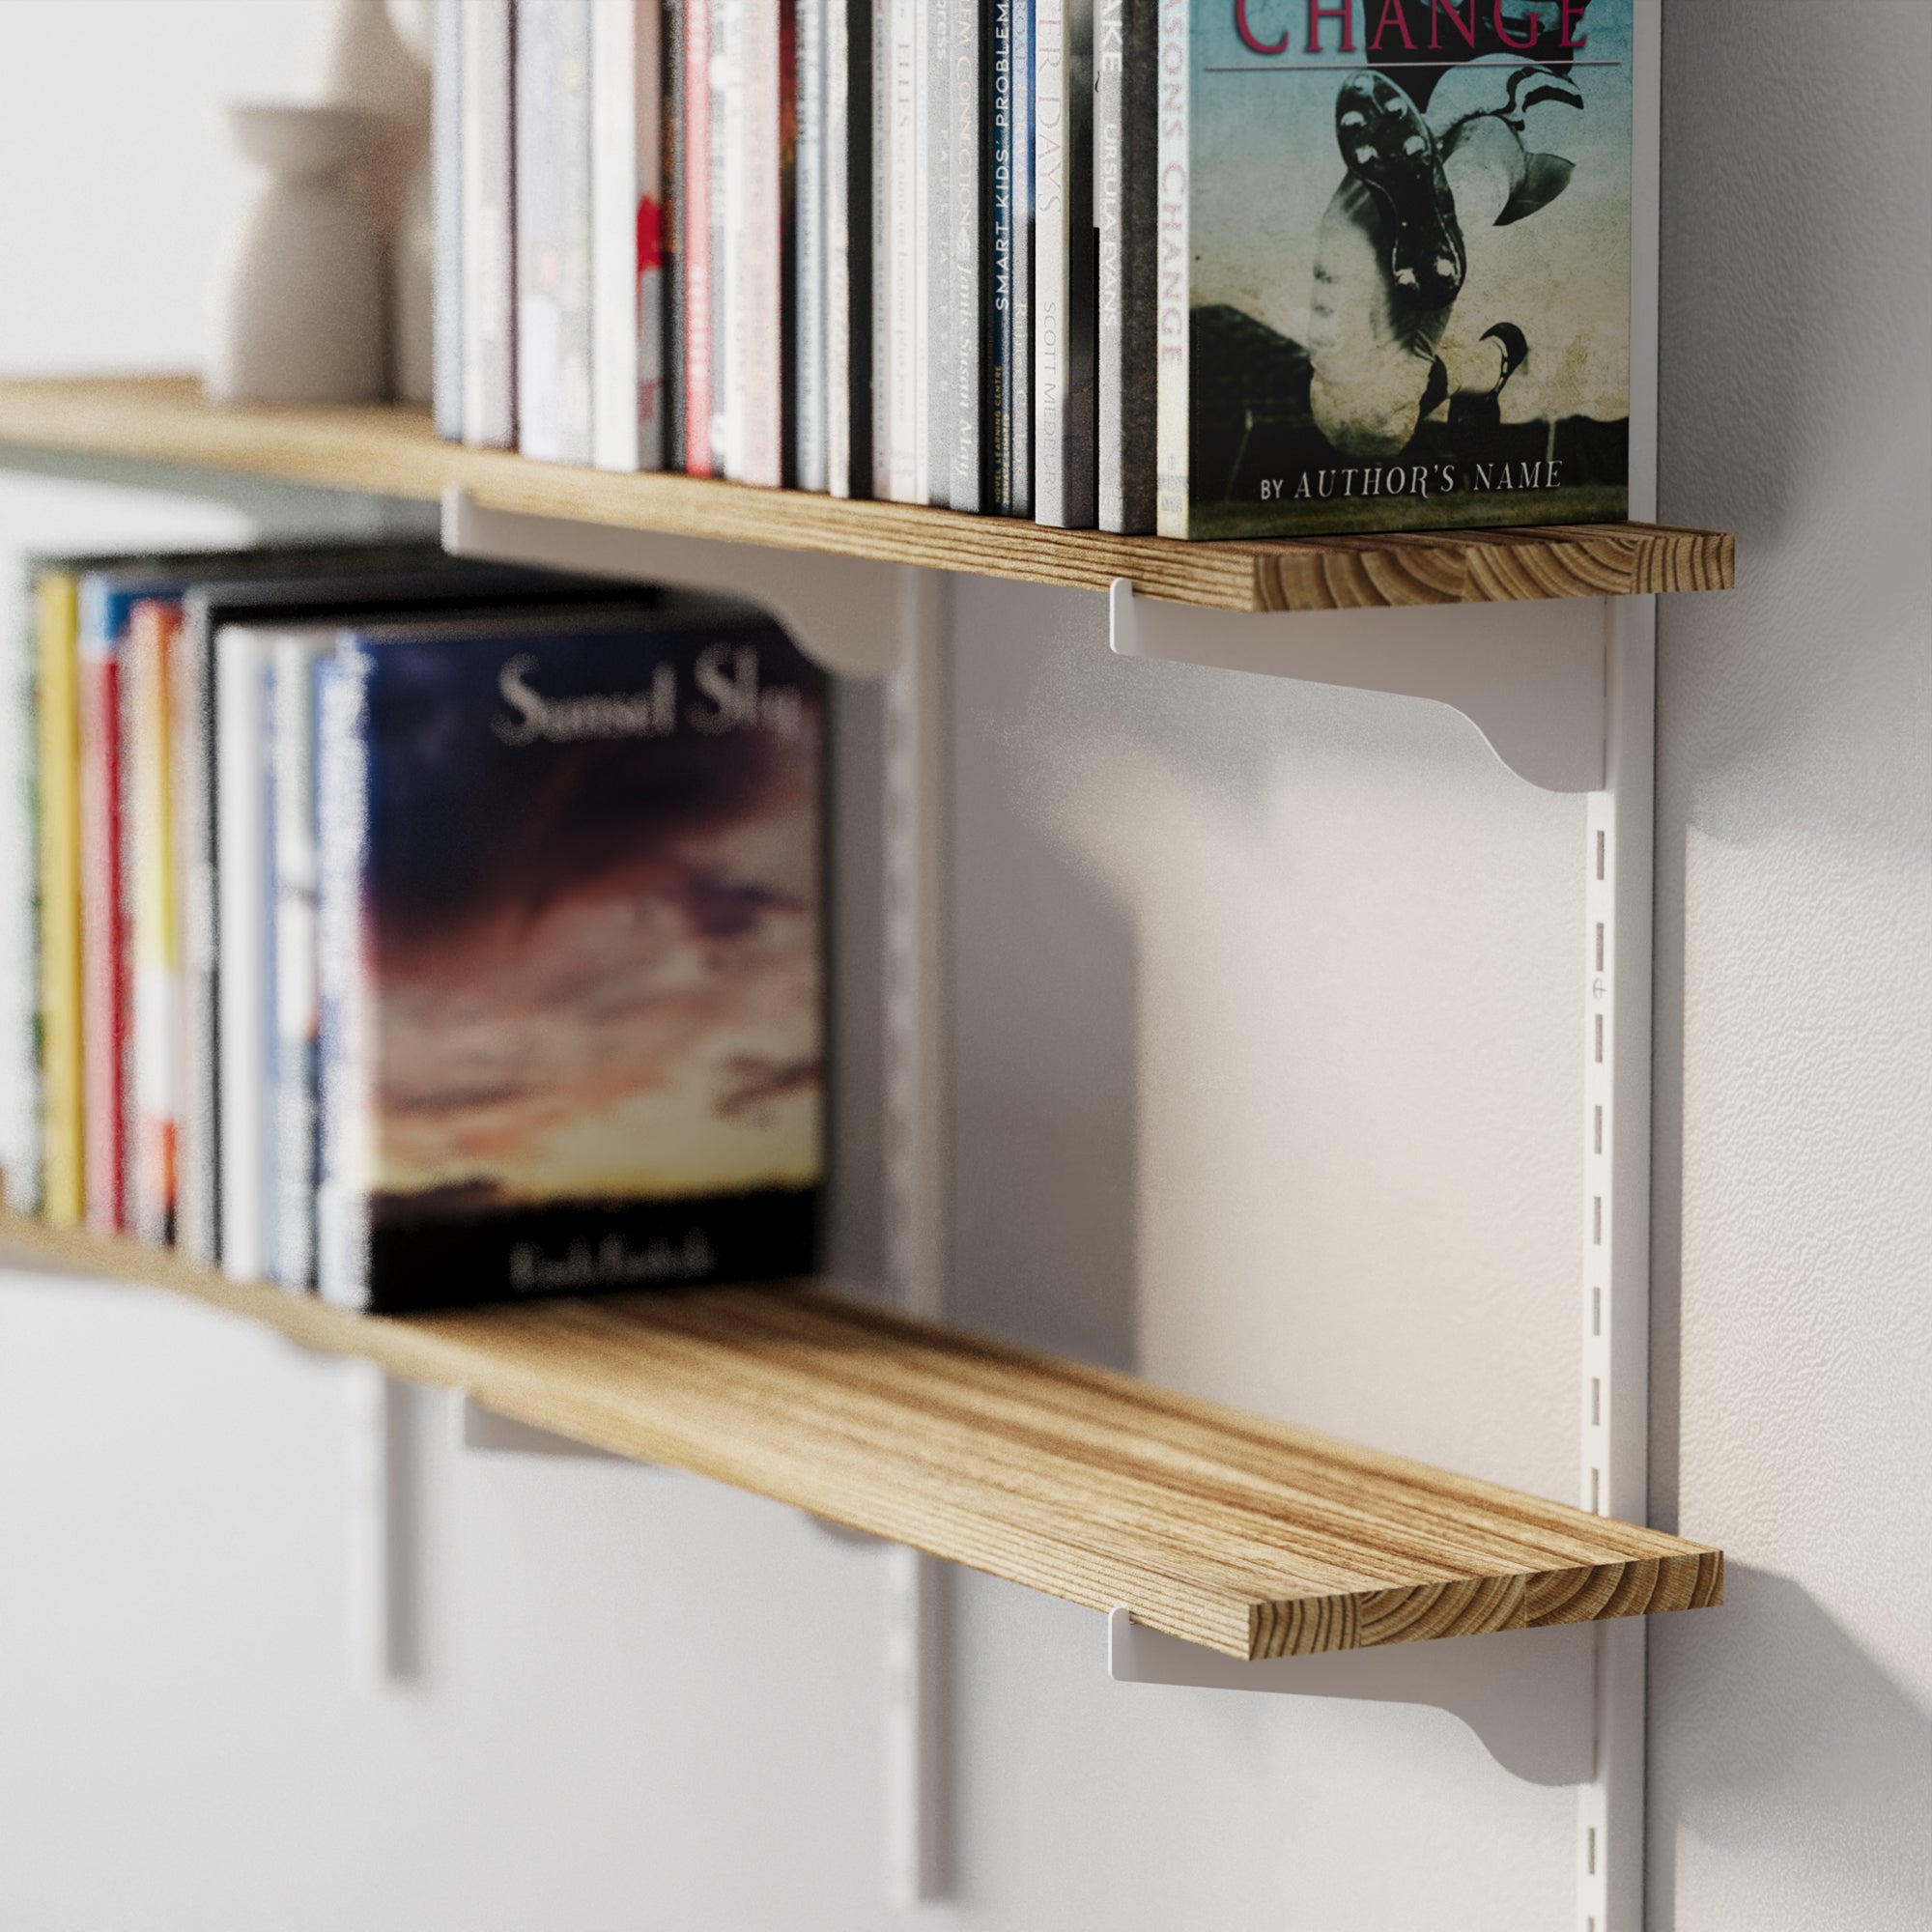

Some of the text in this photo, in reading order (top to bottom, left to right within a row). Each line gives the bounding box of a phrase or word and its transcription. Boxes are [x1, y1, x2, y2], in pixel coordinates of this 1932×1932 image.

[955, 55, 973, 227] CONNECTION
[995, 3, 1010, 311] SMART KIDS' PROBLEM
[1013, 83, 1028, 216] FORWARD
[1037, 96, 1062, 213] DAYS
[1103, 124, 1119, 327] URSULA EVANS
[1160, 161, 1187, 366] CHANGE
[958, 336, 973, 409] Susan
[1043, 300, 1057, 498] SCOTT MEDBURY
[954, 419, 973, 478] May
[994, 468, 1003, 503] NOVEL
[1260, 459, 1563, 500] BY AUTHOR'S NAME
